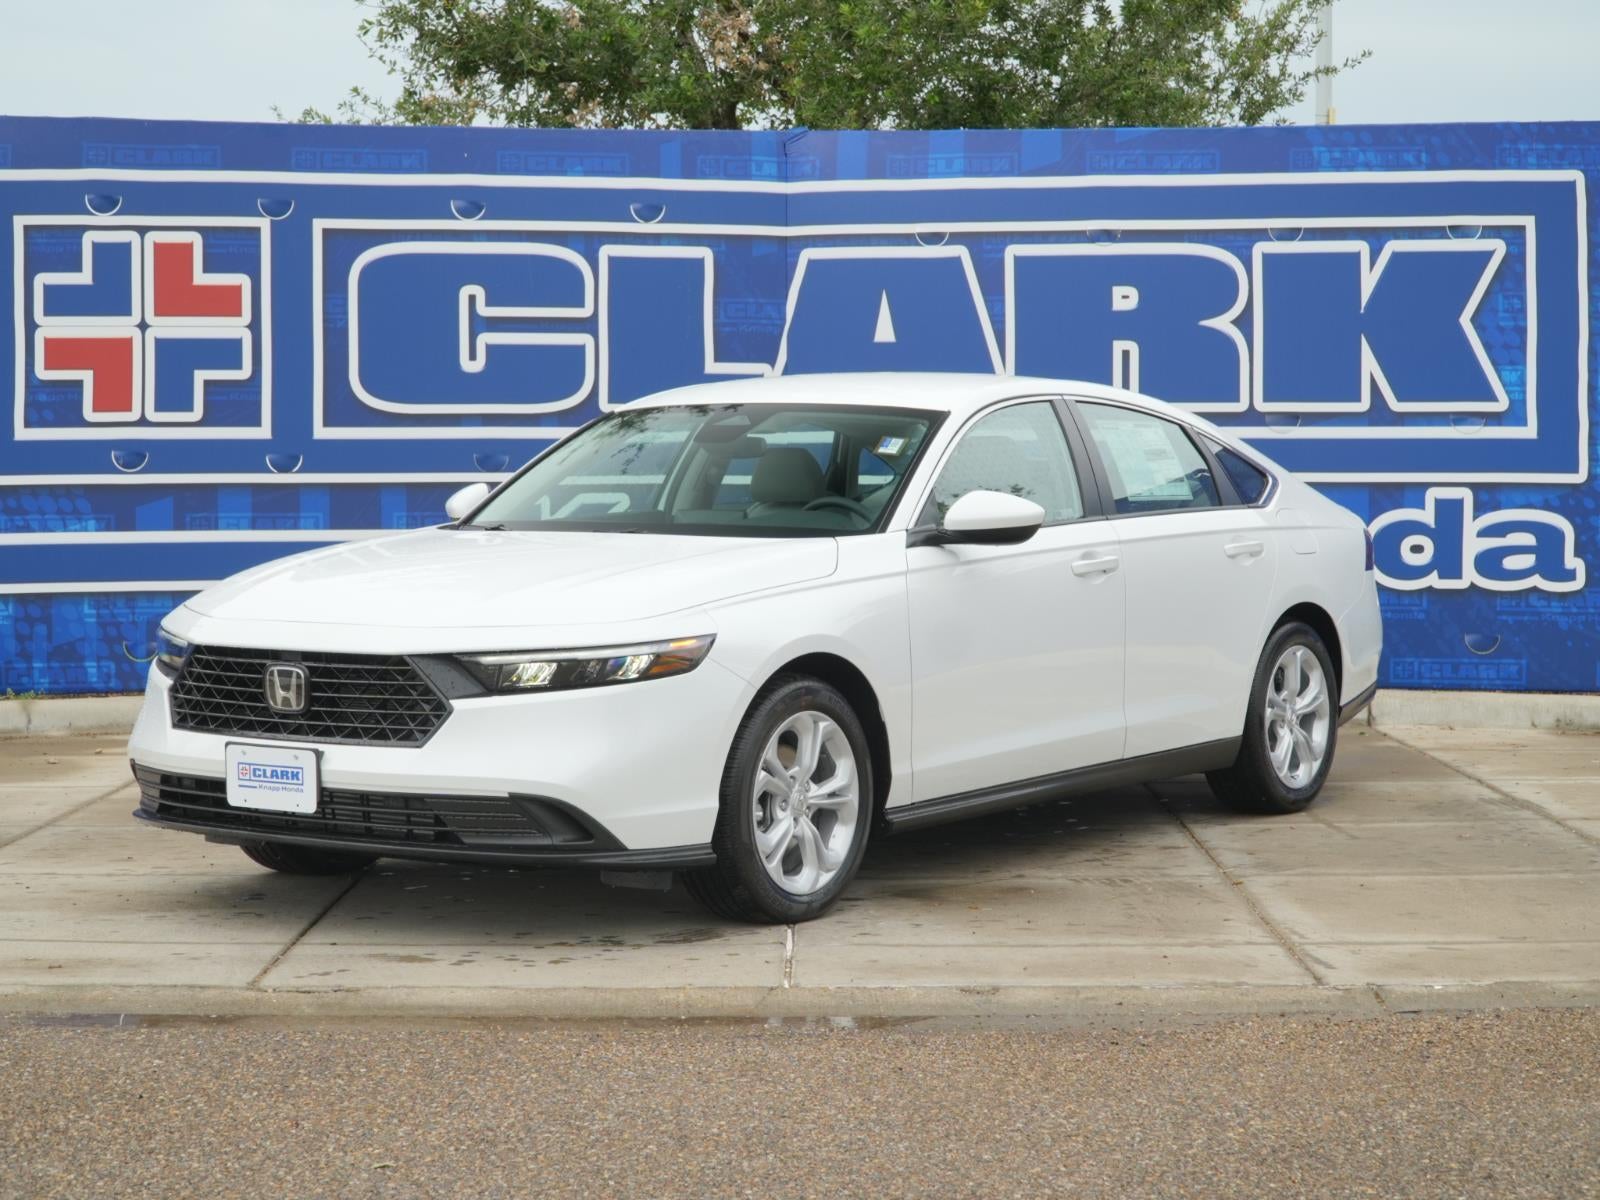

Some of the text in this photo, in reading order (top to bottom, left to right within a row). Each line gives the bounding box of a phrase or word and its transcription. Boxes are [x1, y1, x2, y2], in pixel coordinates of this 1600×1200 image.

[348, 239, 1509, 414] CLARK
[252, 767, 301, 781] CLARK
[259, 784, 281, 793] Knapp
